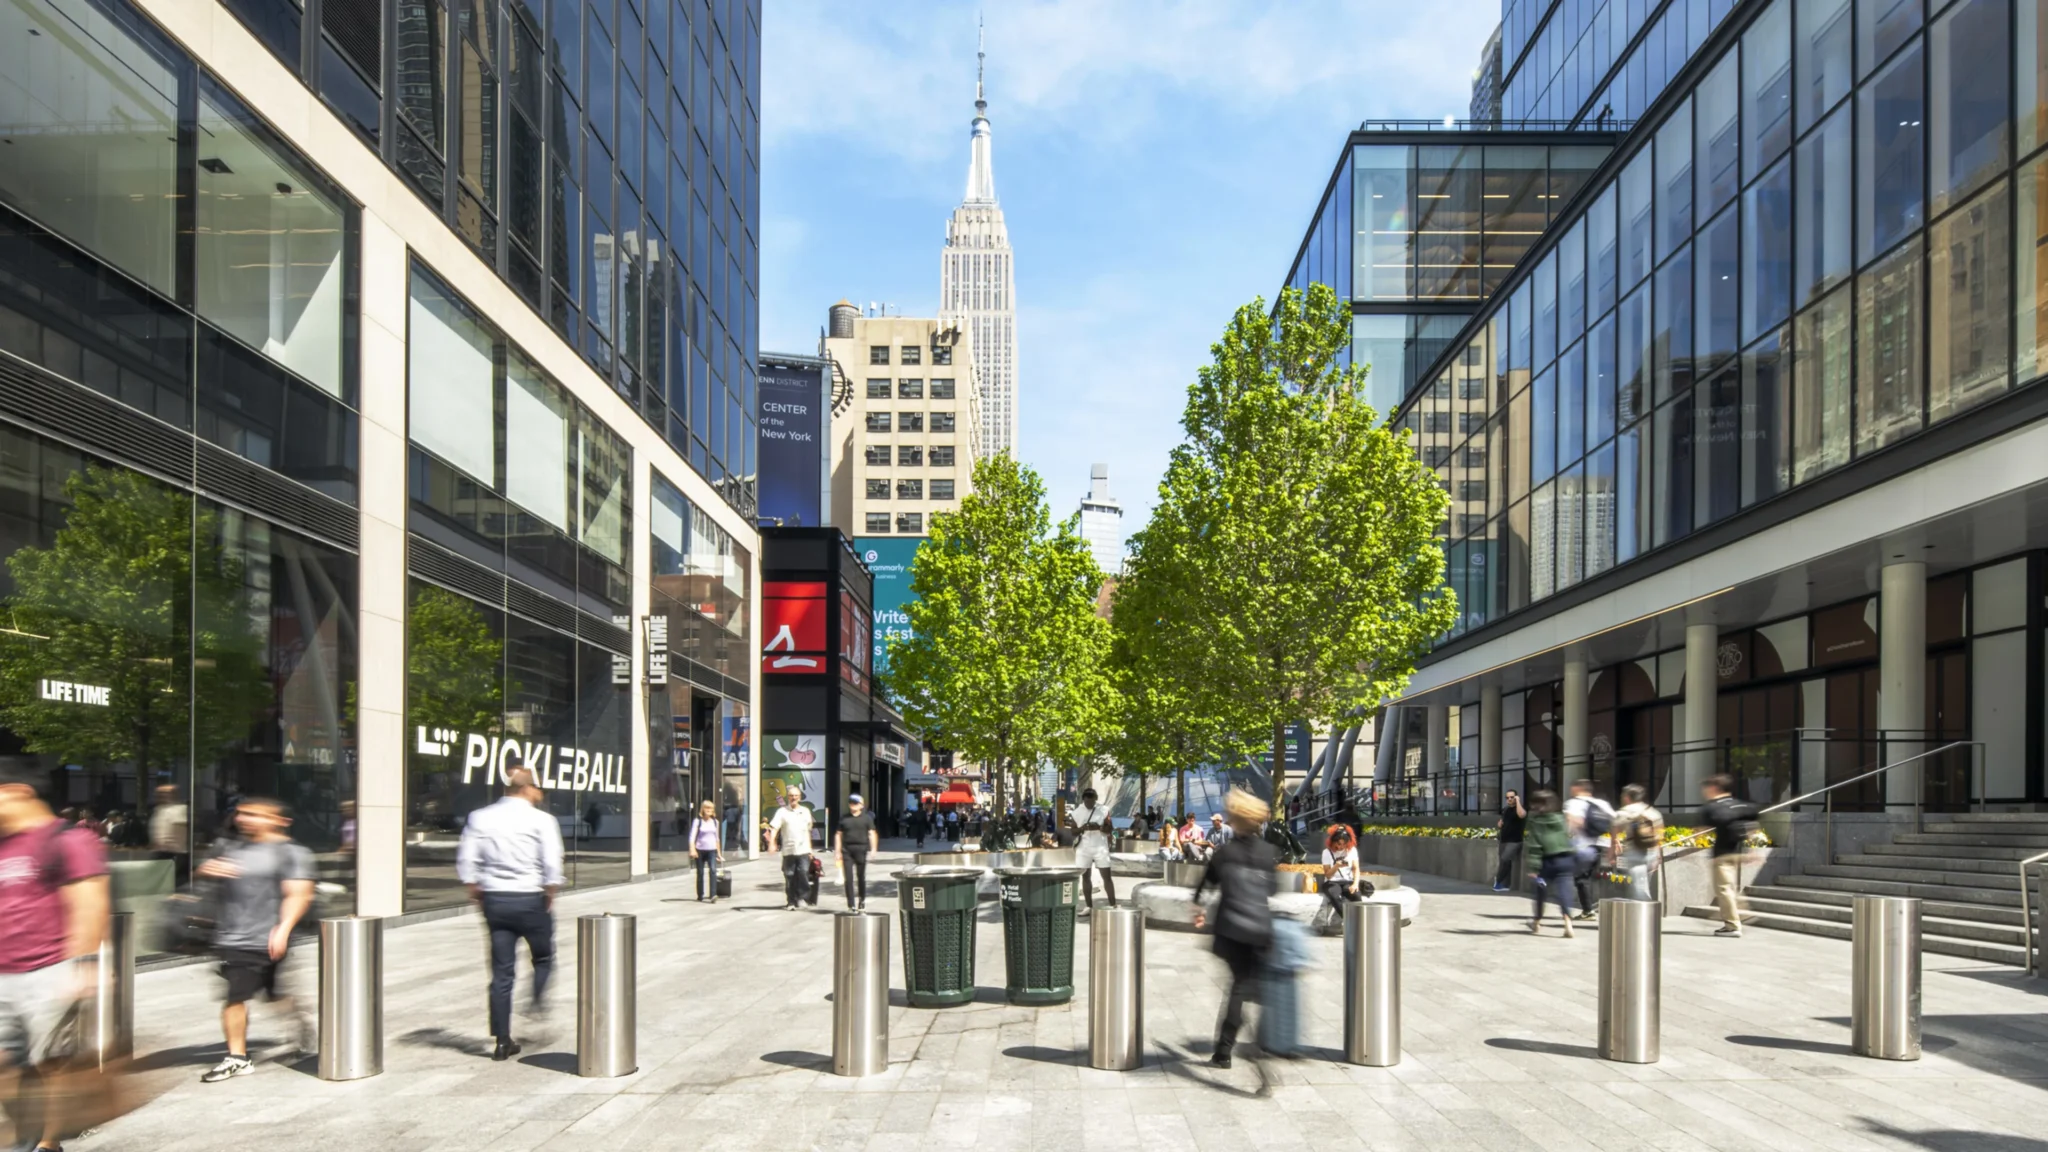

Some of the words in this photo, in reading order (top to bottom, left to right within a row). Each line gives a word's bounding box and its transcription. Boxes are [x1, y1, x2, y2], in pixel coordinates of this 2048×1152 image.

[759, 376, 775, 384] ENN
[776, 377, 809, 388] DISTRICT
[763, 402, 807, 415] CENTER
[760, 417, 769, 425] of
[770, 417, 785, 426] the
[761, 428, 786, 439] New
[788, 431, 812, 442] York
[462, 733, 628, 794] PICKLEBALL
